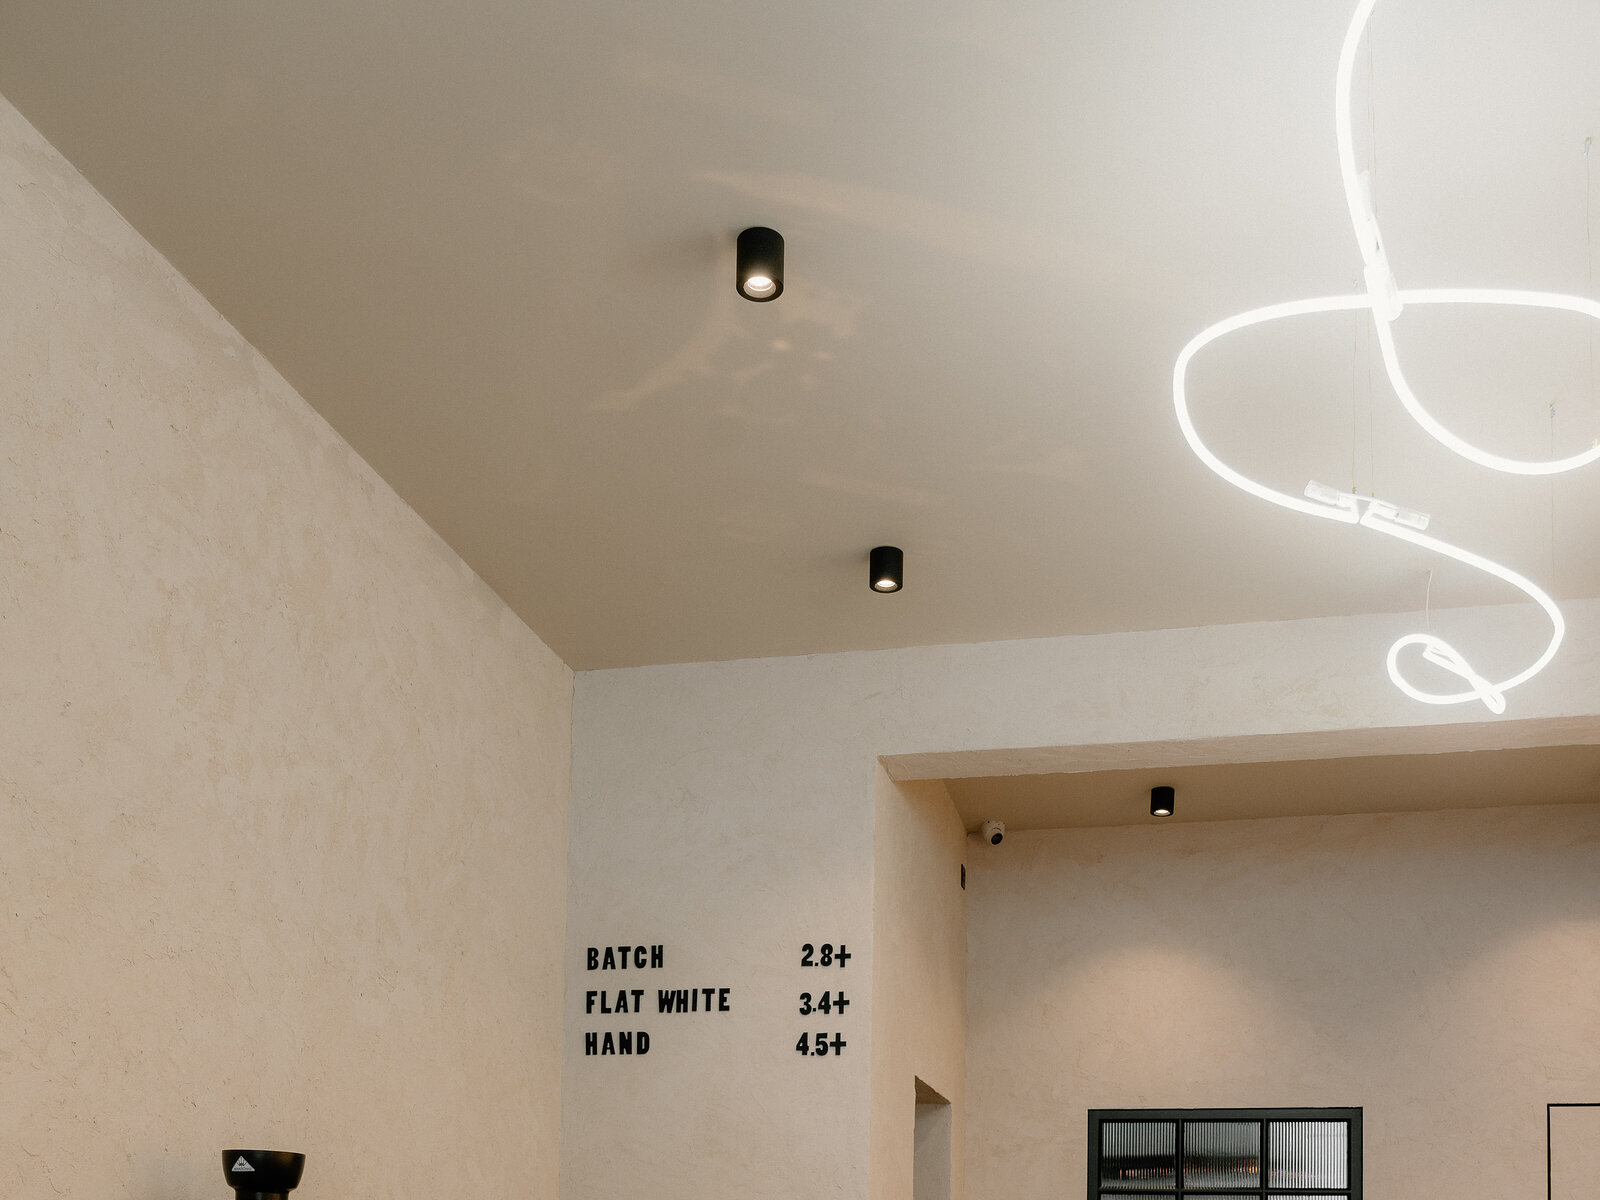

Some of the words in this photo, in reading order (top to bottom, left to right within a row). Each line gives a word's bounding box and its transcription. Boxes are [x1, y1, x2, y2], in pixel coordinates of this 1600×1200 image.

[587, 945, 663, 970] BATCH
[801, 944, 851, 967] 2.8+
[586, 990, 644, 1014] FLAT
[658, 988, 730, 1013] WHITE
[800, 991, 849, 1015] 3.4+
[585, 1032, 649, 1055] HAND
[796, 1032, 846, 1056] 4.5+
